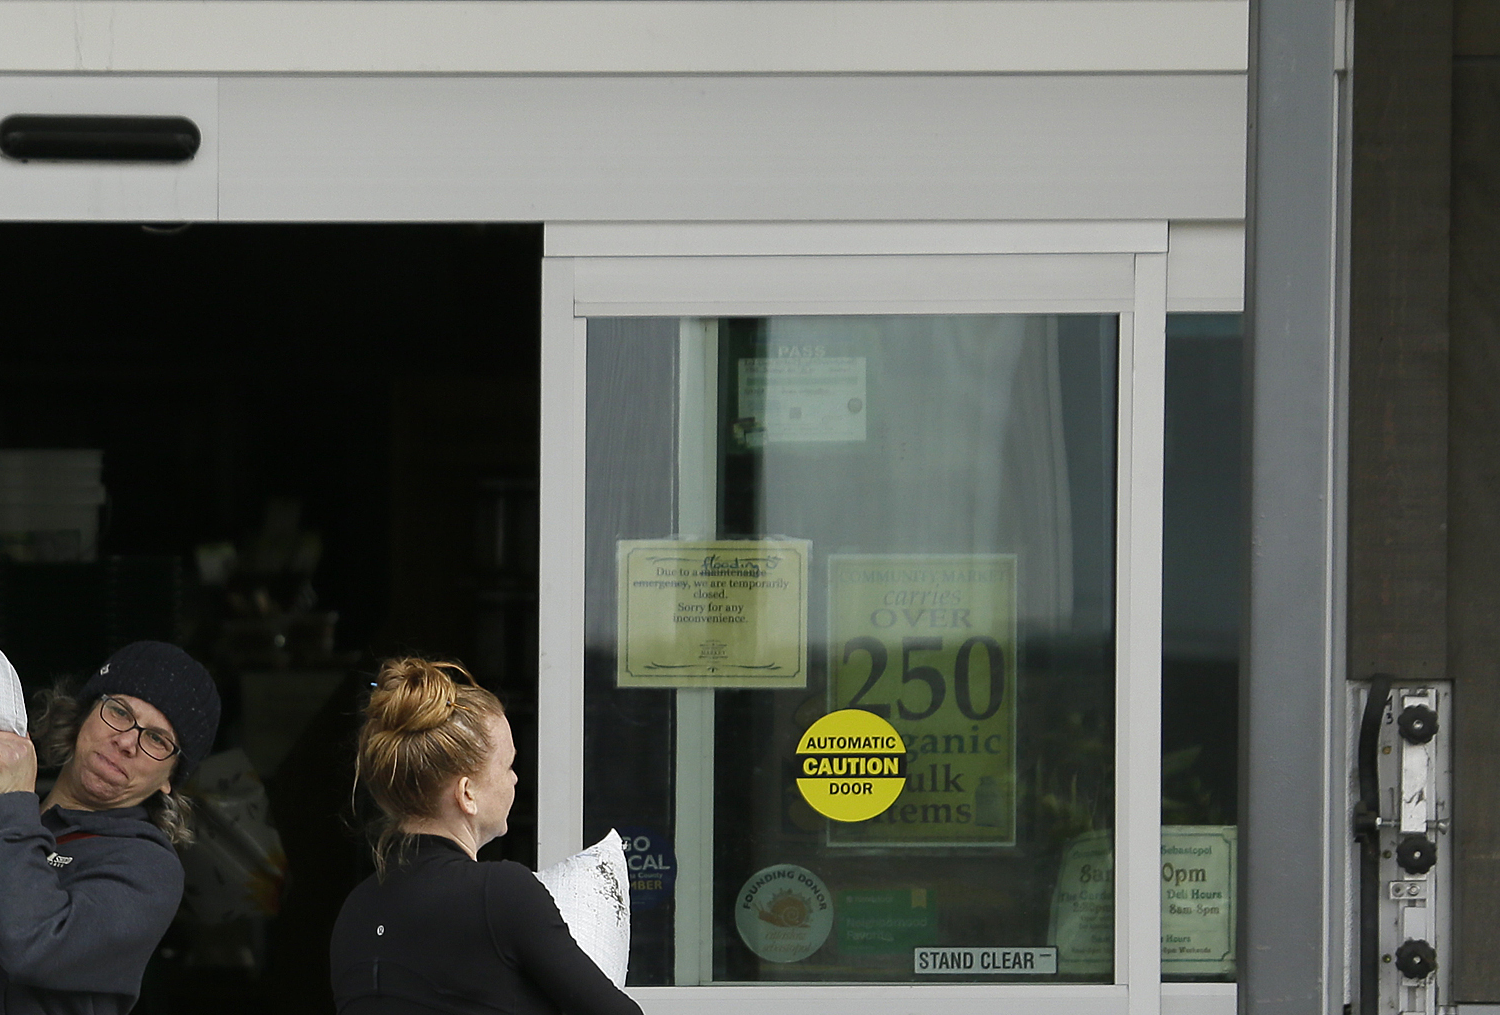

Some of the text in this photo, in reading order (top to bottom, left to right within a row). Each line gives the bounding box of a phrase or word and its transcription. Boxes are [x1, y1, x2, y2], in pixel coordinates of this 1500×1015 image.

[778, 345, 825, 358] PASS
[656, 567, 676, 577] Due
[679, 567, 690, 577] to
[693, 580, 708, 589] we
[710, 580, 726, 589] are
[729, 578, 790, 591] temporarily
[693, 589, 728, 600] closed.
[883, 584, 961, 607] carries
[677, 602, 744, 615] Sorry for any
[673, 613, 748, 624] inconvenience.
[869, 607, 974, 629] OVER
[841, 635, 1006, 721] 250
[806, 736, 897, 750] AUTOMATIC
[904, 725, 1002, 764] ganic
[802, 757, 900, 777] CAUTION
[904, 763, 966, 794] ulk
[828, 782, 874, 796] DOOR
[628, 854, 671, 871] CAL
[742, 870, 827, 911] FOUNDING DONOR
[1166, 888, 1222, 900] Deli Hours
[1166, 934, 1191, 943] Hours
[918, 951, 1035, 970] STAND CLEAR
